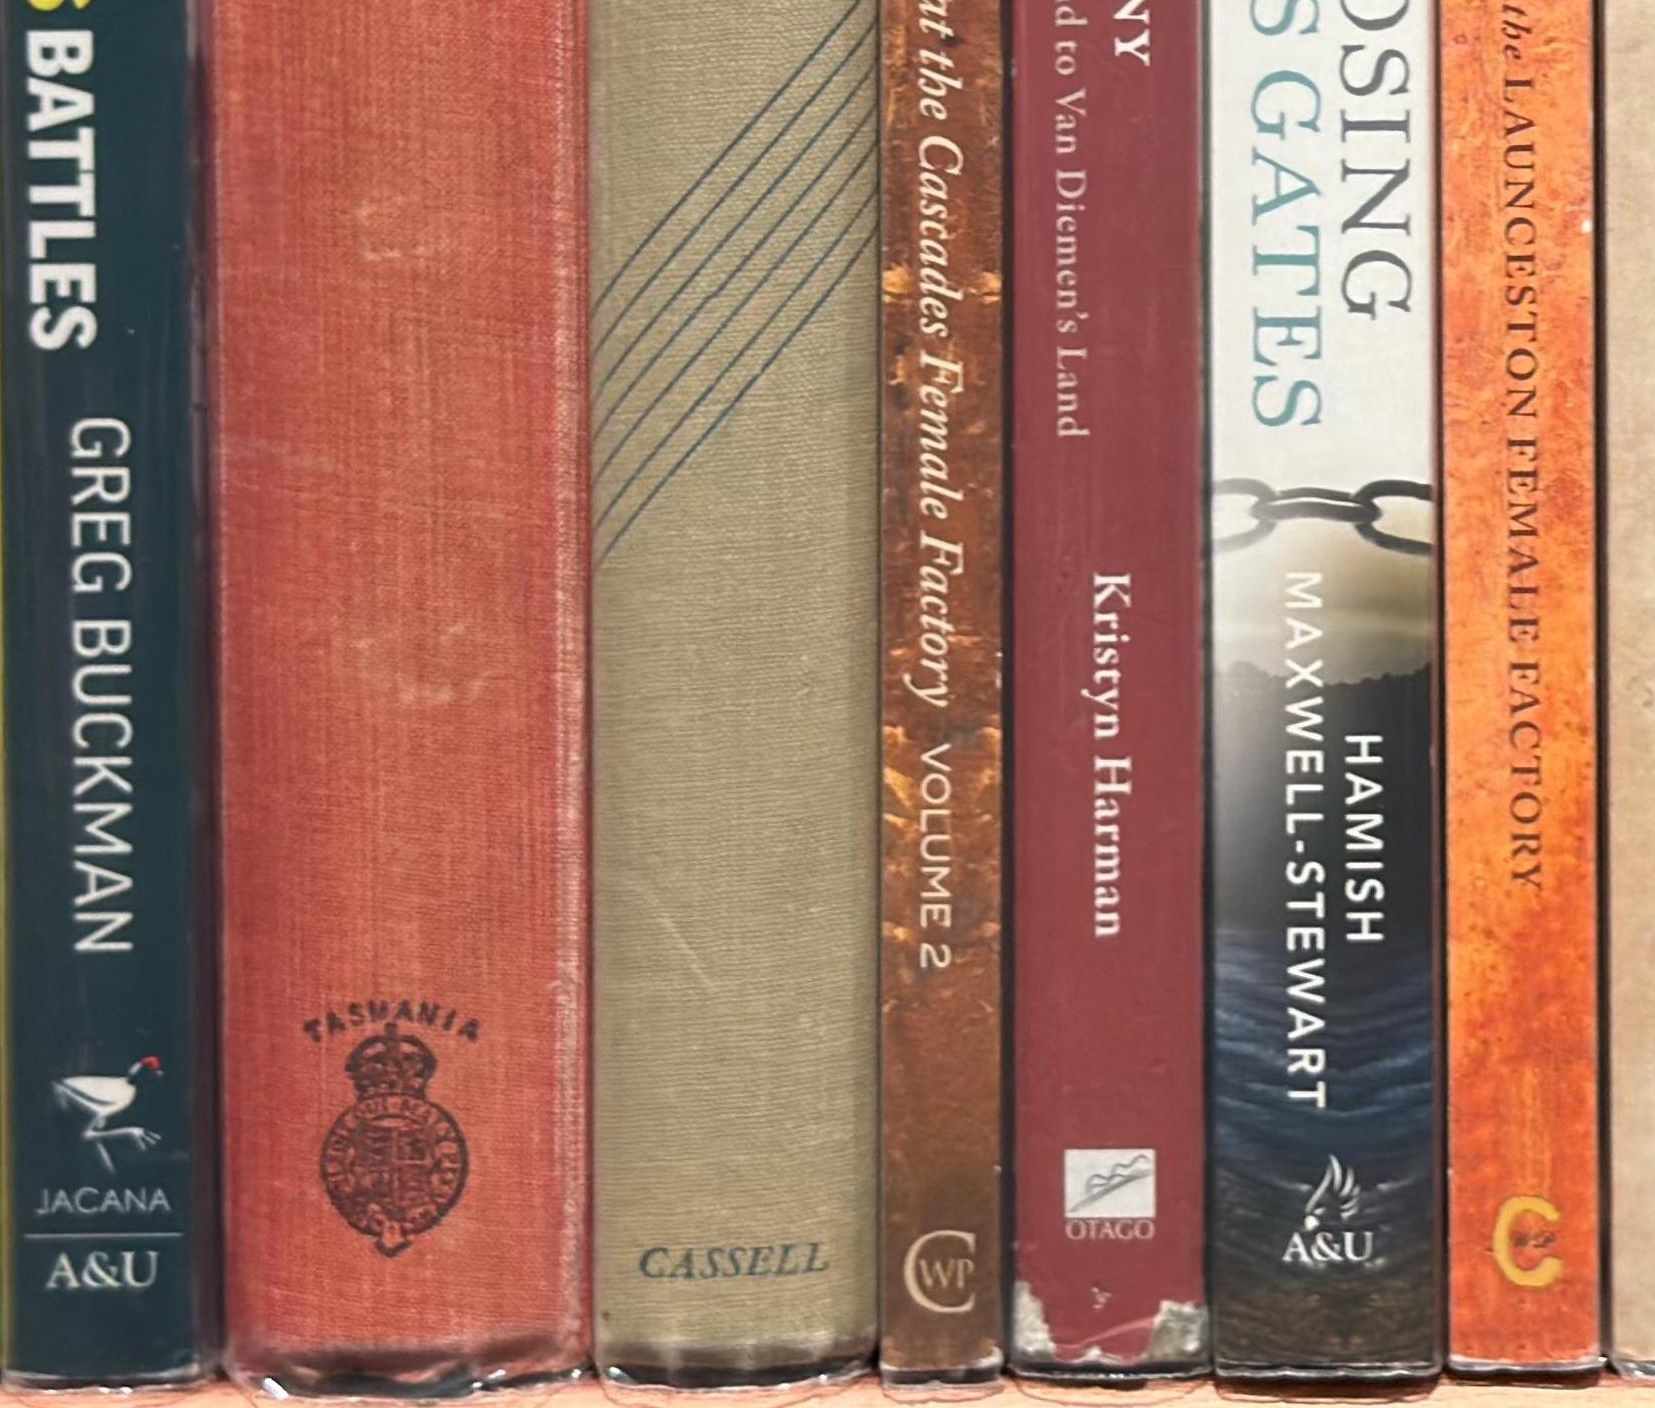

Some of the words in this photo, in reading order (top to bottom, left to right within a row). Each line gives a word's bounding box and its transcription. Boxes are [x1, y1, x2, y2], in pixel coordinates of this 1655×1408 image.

[918, 48, 964, 121] the
[1055, 39, 1079, 76] to
[1501, 3, 1533, 61] the
[26, 29, 98, 352] BATTLES
[1055, 88, 1087, 154] Van
[918, 135, 965, 339] Cascades
[1056, 169, 1090, 334] Diemen's
[1250, 69, 1324, 428] GATES
[1503, 78, 1540, 419] LAUNCESTON
[919, 349, 966, 520] Female
[1056, 346, 1090, 438] Land
[69, 416, 133, 593] GREG
[1507, 438, 1541, 644] FEMALE
[902, 530, 966, 708] Factory
[1080, 572, 1132, 740] Kristyn
[70, 618, 135, 953] BUCKMAN
[919, 742, 952, 929] VOLUME
[1093, 755, 1133, 939] Harman
[1284, 571, 1327, 1109] MAXWELL-STEWART
[1345, 734, 1386, 942] HAMISH
[1509, 661, 1544, 891] FACTORY
[302, 998, 481, 1044] TASMANIA
[919, 943, 952, 969] 2
[35, 1187, 172, 1216] JACANA
[47, 1250, 161, 1289] A&U
[637, 1241, 831, 1280] CASSELL
[1065, 1218, 1156, 1241] OTAGO
[1282, 1231, 1375, 1264] A&U
